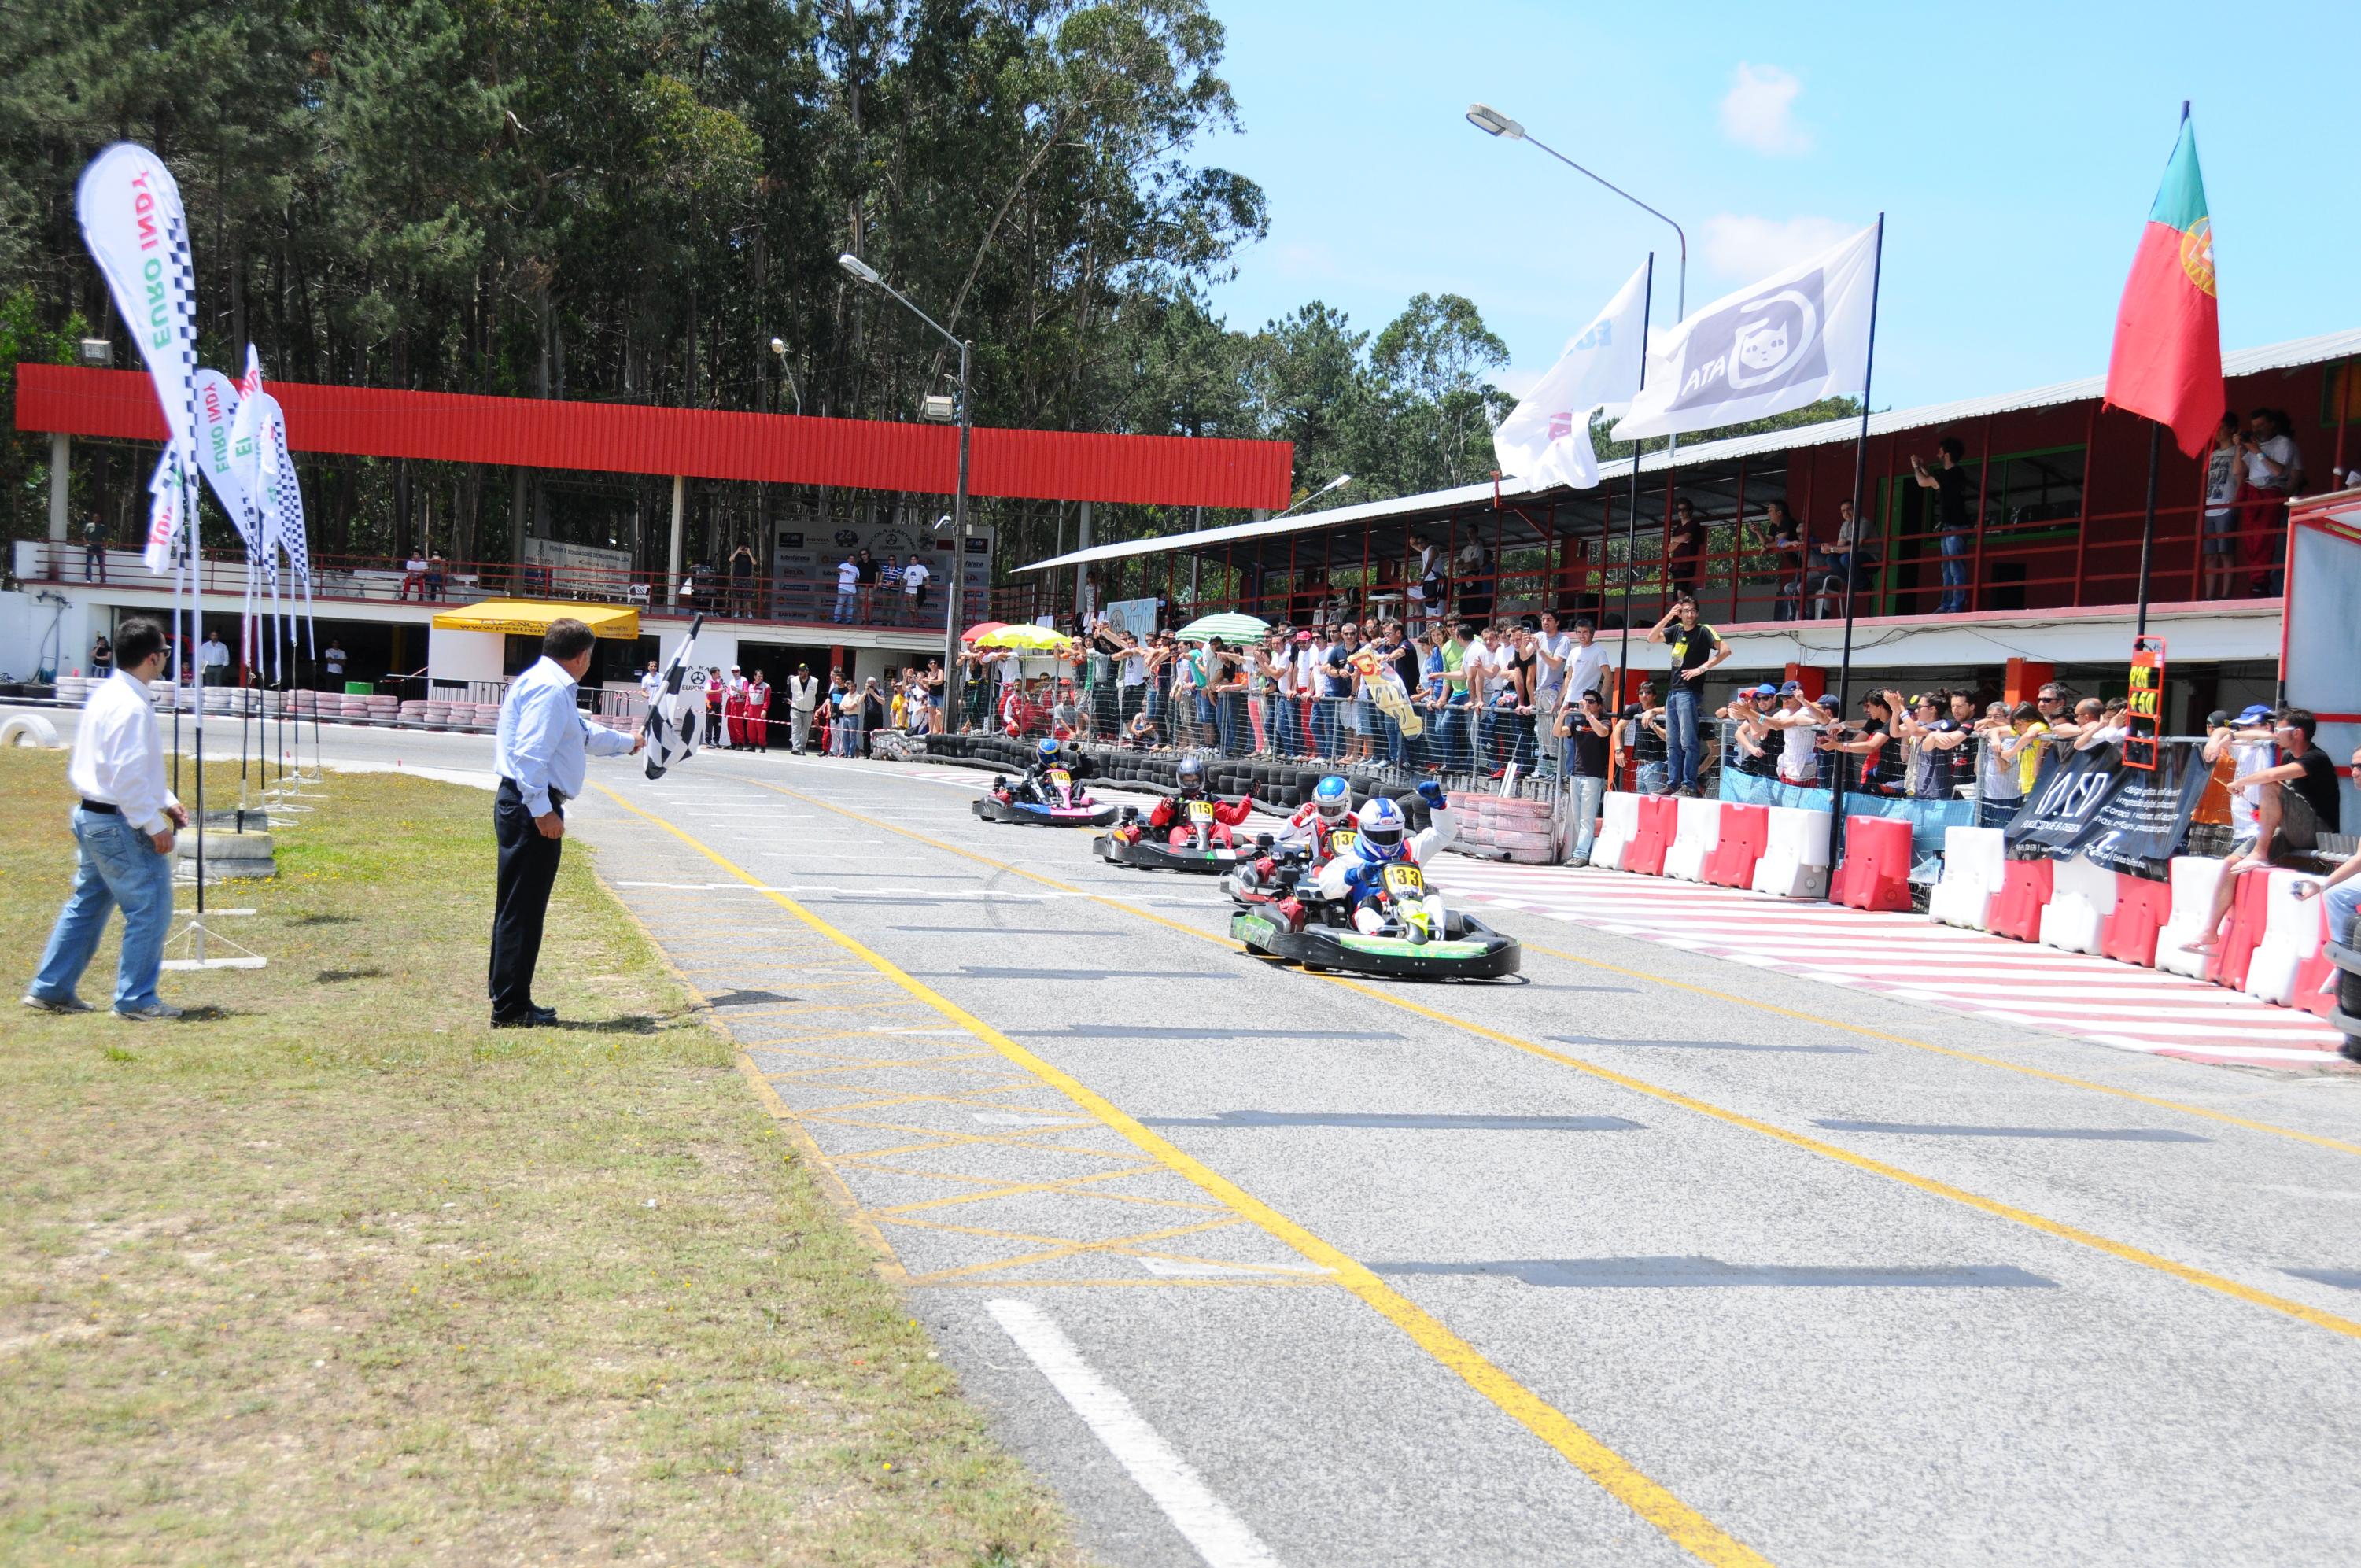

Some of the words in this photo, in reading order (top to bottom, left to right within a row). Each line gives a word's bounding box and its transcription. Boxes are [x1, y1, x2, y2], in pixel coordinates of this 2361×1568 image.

[1053, 771, 1069, 781] 105
[1193, 803, 1212, 814] 115
[1386, 869, 1420, 887] 133
